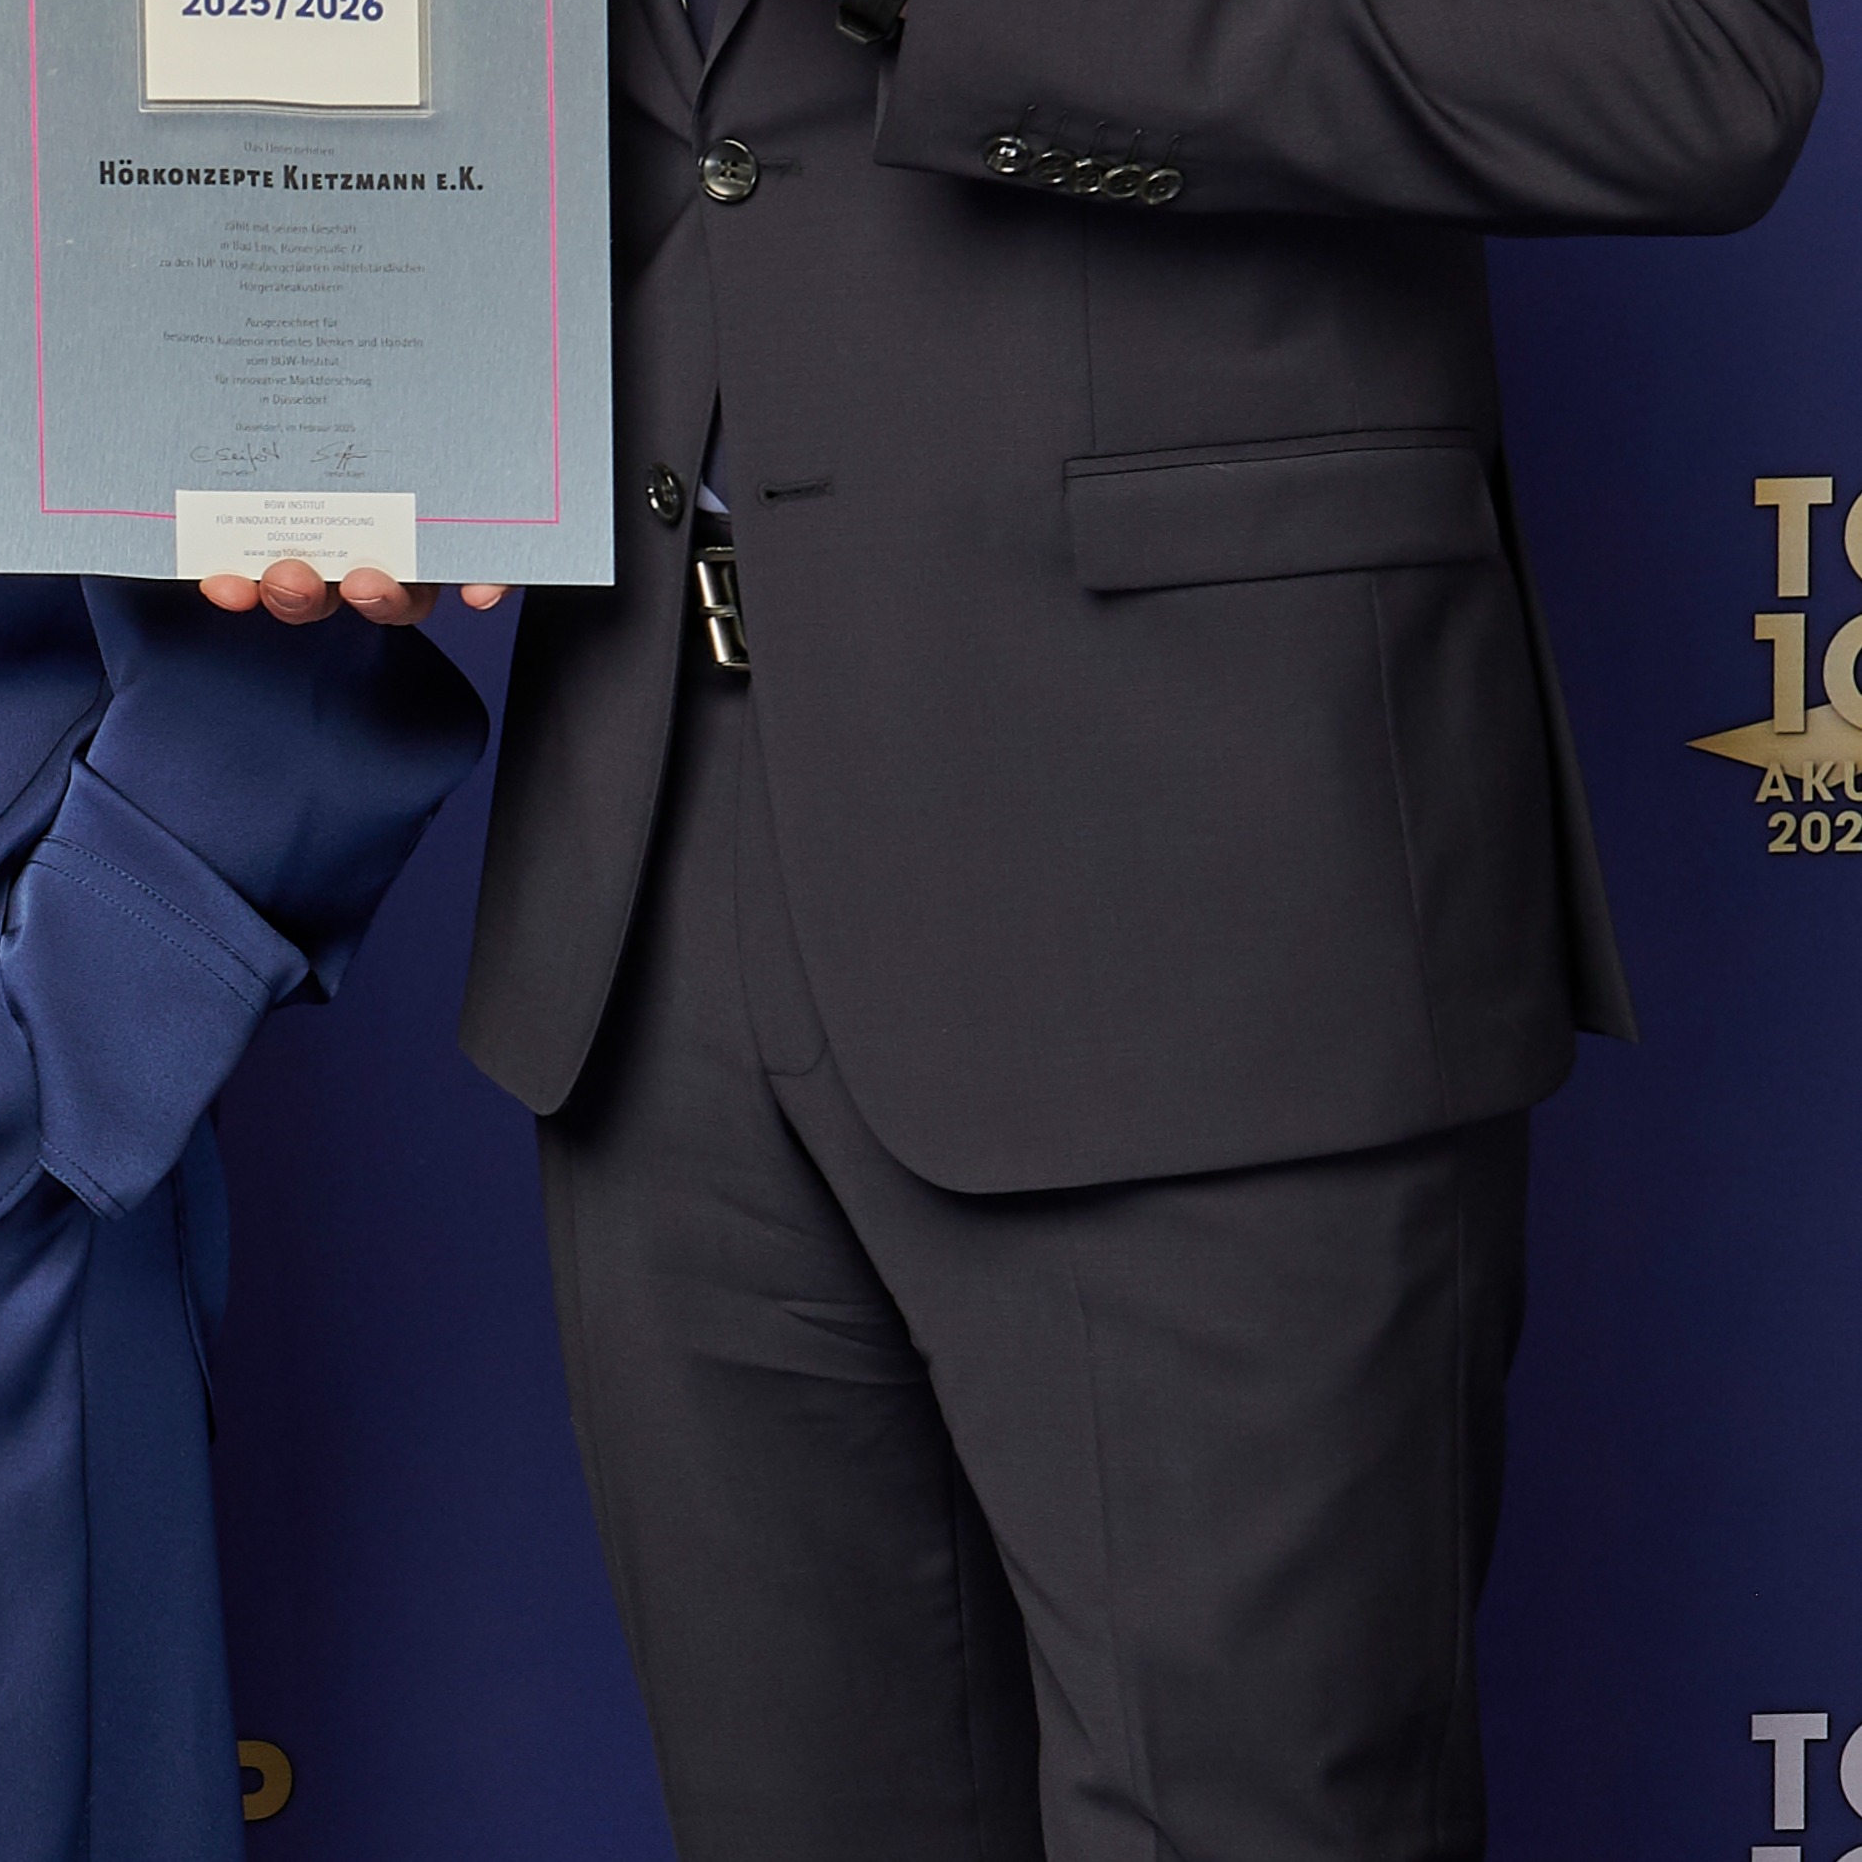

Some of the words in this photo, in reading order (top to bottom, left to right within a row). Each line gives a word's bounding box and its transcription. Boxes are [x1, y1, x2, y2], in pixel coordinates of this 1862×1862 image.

[245, 317, 319, 330] Ausgezeichnet
[357, 337, 378, 348] und
[272, 393, 327, 405] Düsseldorf
[264, 499, 286, 510] BGW
[287, 499, 325, 510] INSTITUT
[216, 514, 234, 526] FÜR
[236, 515, 287, 526] INNOVATIVE
[290, 516, 375, 527] MARKTFORSCHUNG
[267, 530, 324, 542] DÜSSELDORF
